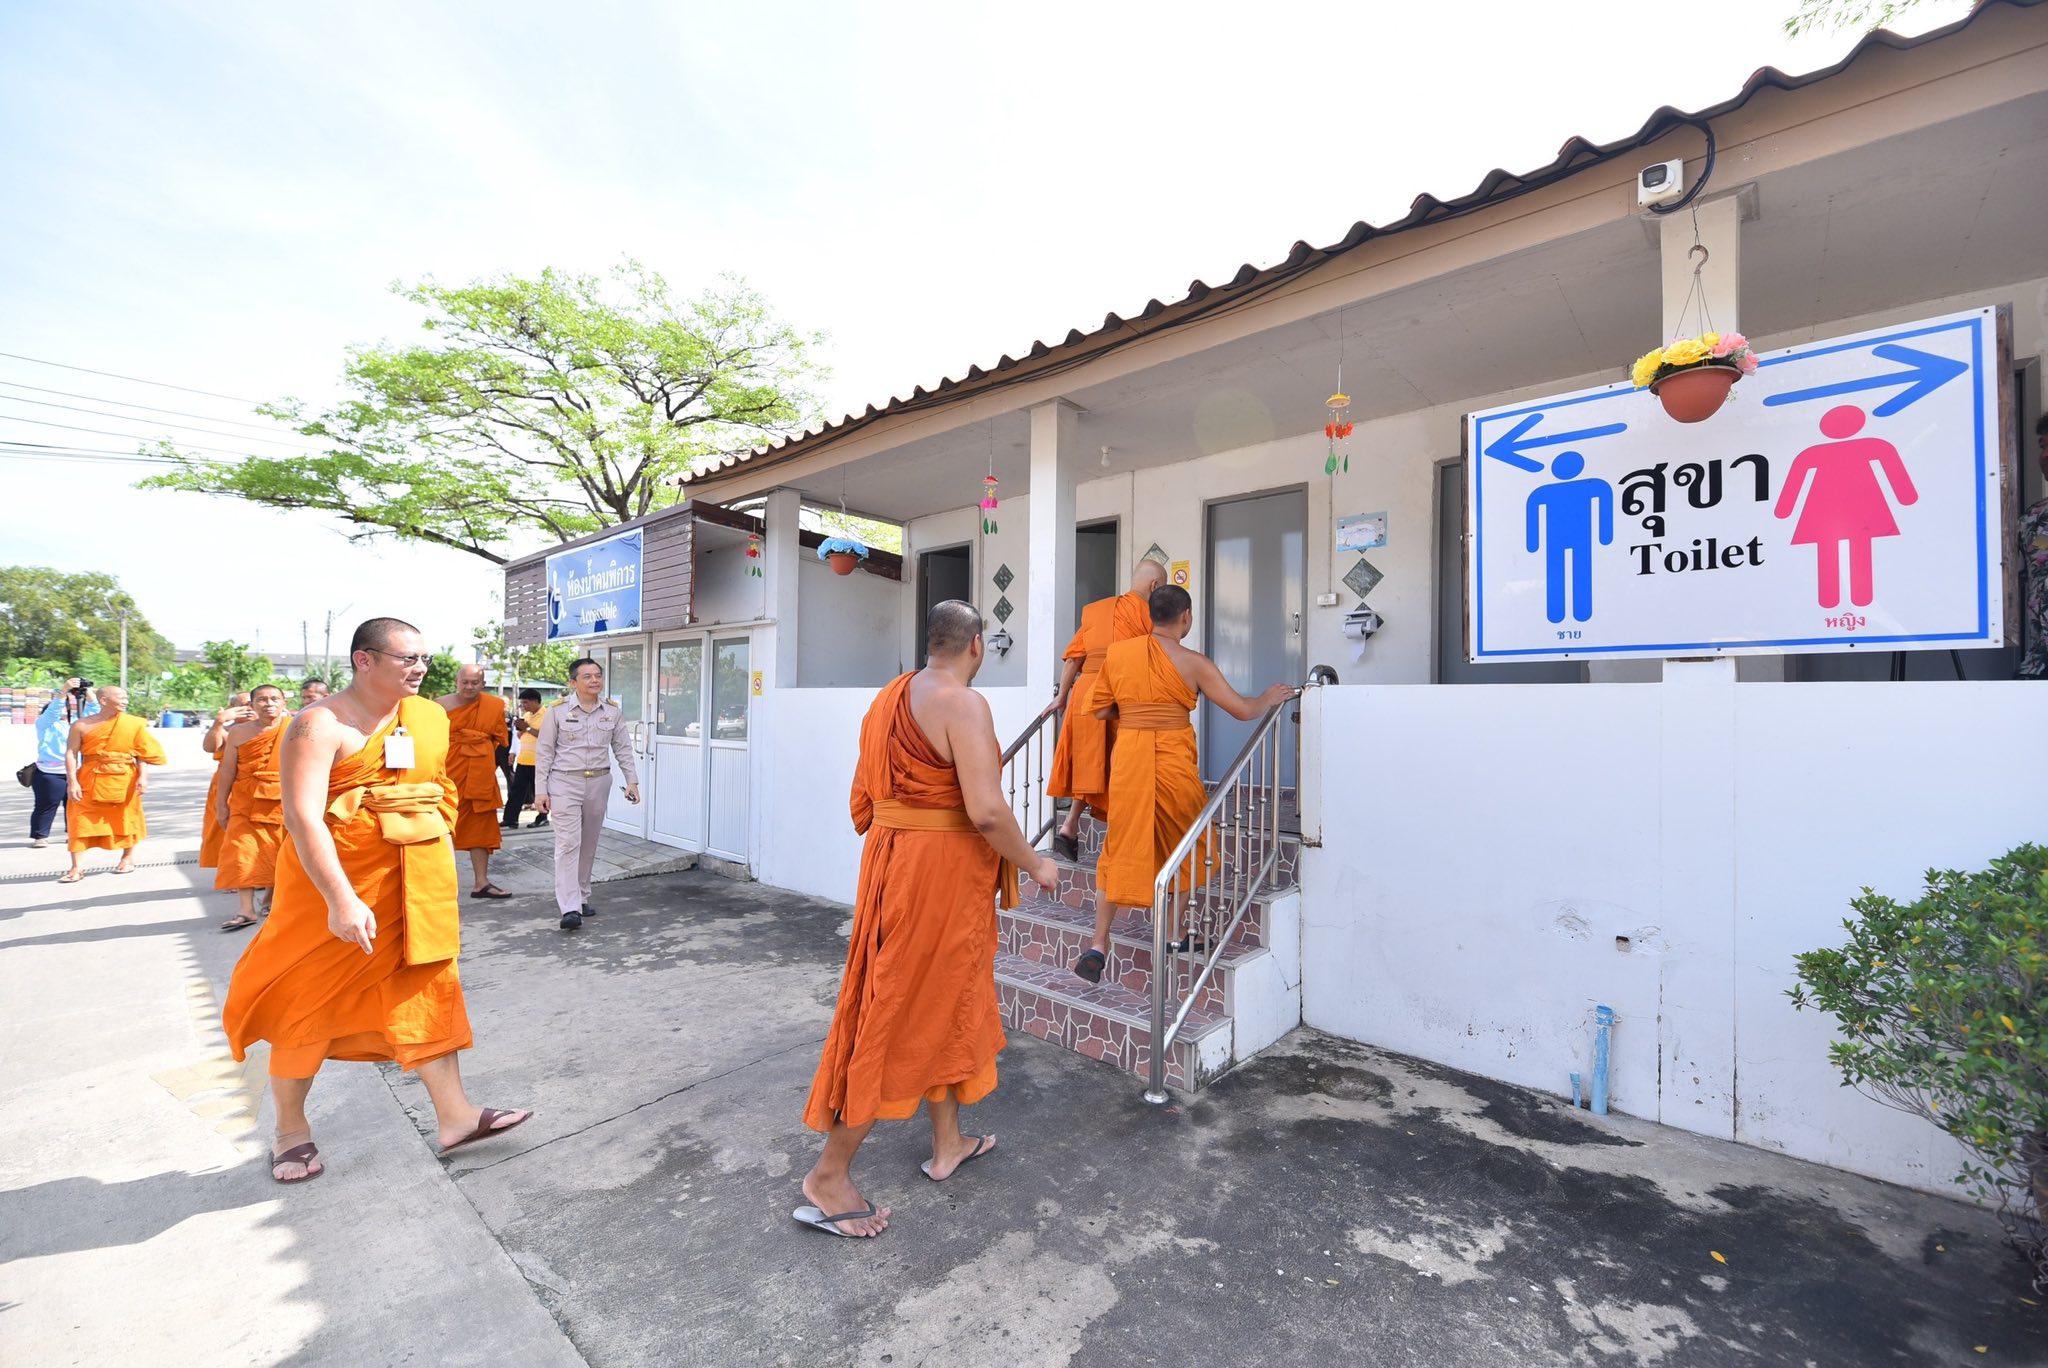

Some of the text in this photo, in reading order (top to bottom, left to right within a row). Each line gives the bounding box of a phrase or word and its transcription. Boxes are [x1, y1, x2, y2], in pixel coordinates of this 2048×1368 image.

[1618, 454, 1769, 537] สุขา
[1630, 536, 1765, 575] Toilet
[1556, 630, 1582, 640] ชาย
[1824, 612, 1866, 631] หญิง
